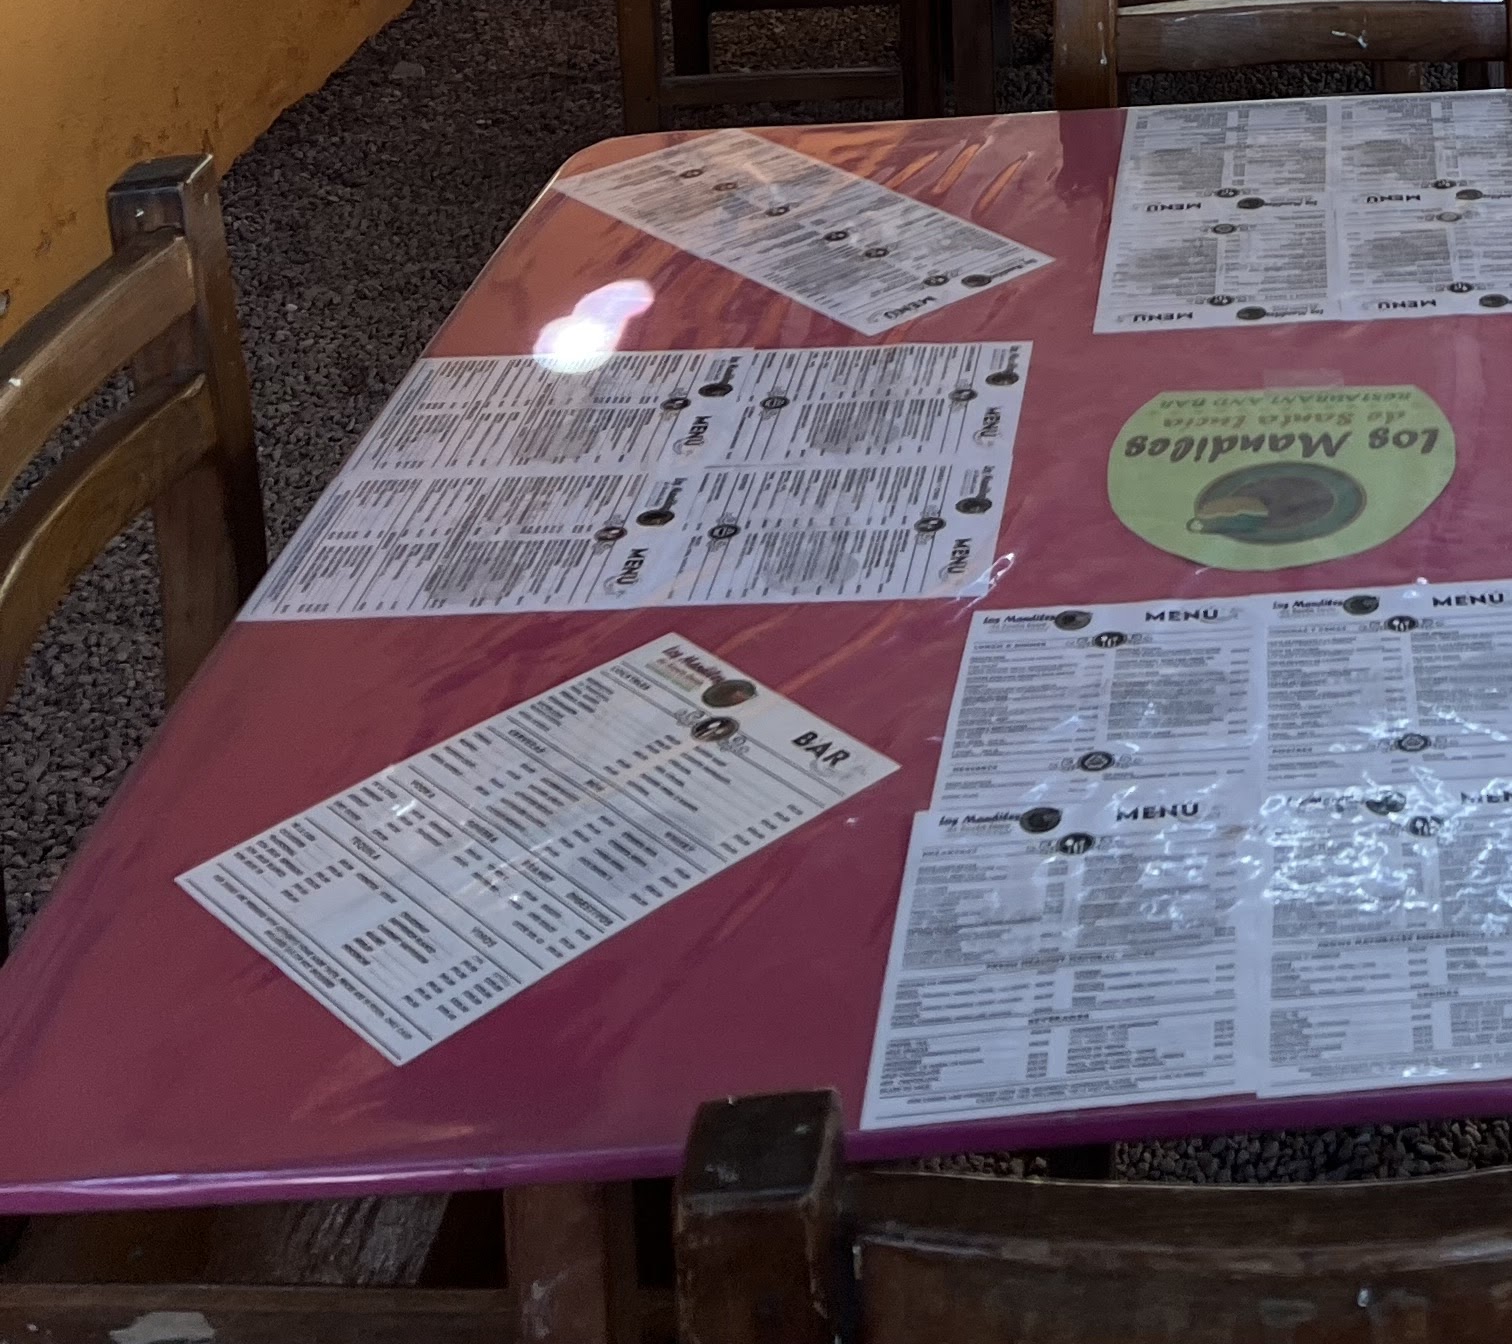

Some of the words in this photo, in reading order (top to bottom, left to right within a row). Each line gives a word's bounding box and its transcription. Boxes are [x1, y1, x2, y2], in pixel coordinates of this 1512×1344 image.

[1214, 394, 1265, 406] AND
[1271, 391, 1411, 404] RESTAURANT
[1258, 410, 1355, 426] Santa
[1125, 429, 1352, 464] Mandiles
[1368, 426, 1439, 455] Los
[791, 731, 852, 766] BAR
